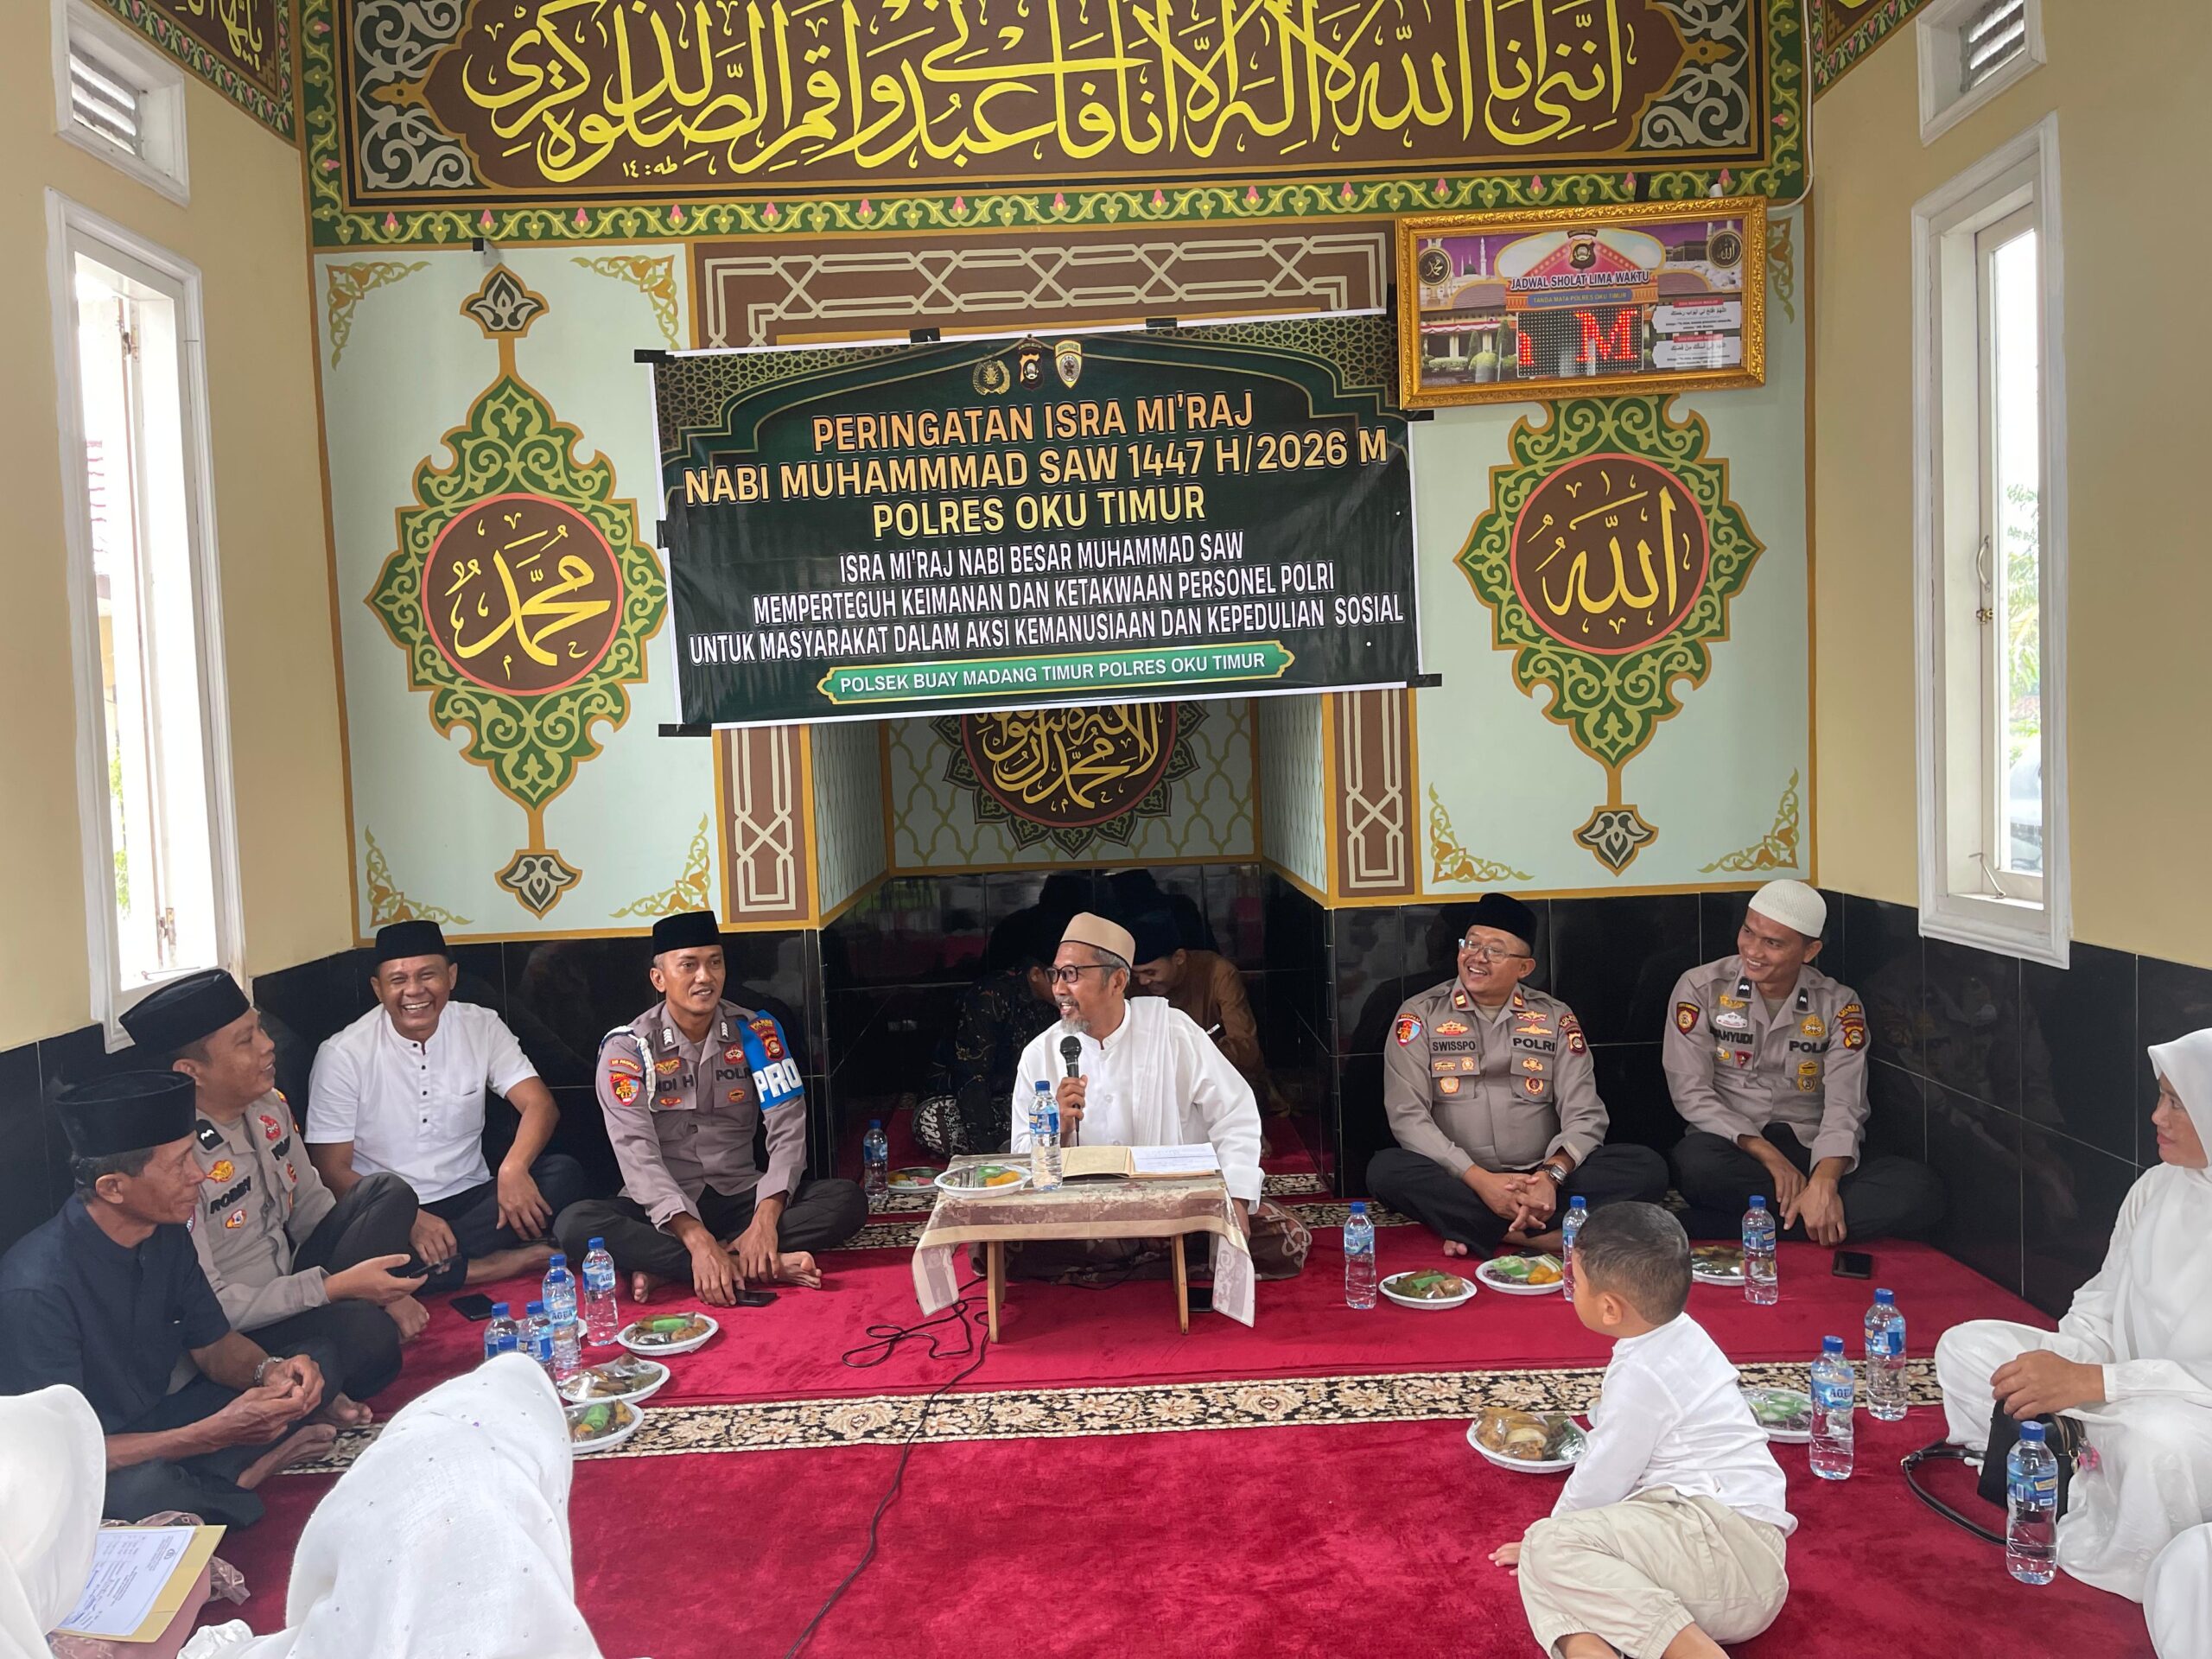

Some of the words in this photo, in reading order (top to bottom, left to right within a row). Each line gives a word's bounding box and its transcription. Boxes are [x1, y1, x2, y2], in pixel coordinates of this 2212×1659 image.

[1510, 277, 1548, 289] JADWAL
[1551, 275, 1586, 287] SHOLAT
[1589, 273, 1612, 284] LIMA
[1614, 270, 1649, 283] WAKTU
[813, 406, 1034, 453] PERINGATAN
[1046, 399, 1126, 439] ISRA
[1137, 390, 1254, 433] MI'RAJ
[684, 465, 769, 505] NABI
[780, 452, 1027, 499] MUHAMMMAD
[1039, 444, 1117, 485] SAW
[1128, 439, 1205, 480] 1447
[1216, 431, 1347, 474] H/2026
[1360, 429, 1387, 463] M
[873, 497, 1004, 538] POLRES
[1015, 492, 1087, 530] OKU
[1096, 486, 1205, 525] TIMUR
[839, 552, 886, 584] ISRA
[890, 548, 952, 582] MI'RAJ
[958, 545, 1005, 577] NABI
[1010, 542, 1071, 573] BESAR
[1077, 534, 1194, 569] MUHAMMAD
[1199, 531, 1244, 562] SAW
[753, 589, 896, 626] MEMPERTEGUH
[901, 583, 1001, 616] KEIMANAN
[1009, 581, 1050, 610] DAN
[1054, 572, 1173, 607] KETAKWAAN
[1179, 567, 1276, 600] PERSONEL
[1281, 561, 1335, 594] POLRI
[690, 632, 756, 665] UNTUK
[760, 626, 889, 661] MASYARAKAT
[894, 621, 960, 652] DALAM
[965, 620, 1009, 648] AKSI
[1015, 610, 1156, 646] KEMANUSIAAN
[1161, 608, 1202, 637] DAN
[1207, 599, 1325, 634] KEPEDULIAN
[1334, 594, 1405, 626] SOSIAL
[841, 674, 909, 693] POLSEK
[913, 671, 957, 690] BUAY
[962, 667, 1038, 686] MADANG
[1042, 664, 1095, 682] TIMUR
[1099, 659, 1167, 677] POLRES
[1171, 657, 1209, 673] OKU
[1212, 652, 1266, 671] TIMUR
[1432, 1039, 1477, 1052] SWISSPO
[1513, 1037, 1556, 1052] POLRI
[683, 1074, 695, 1089] H
